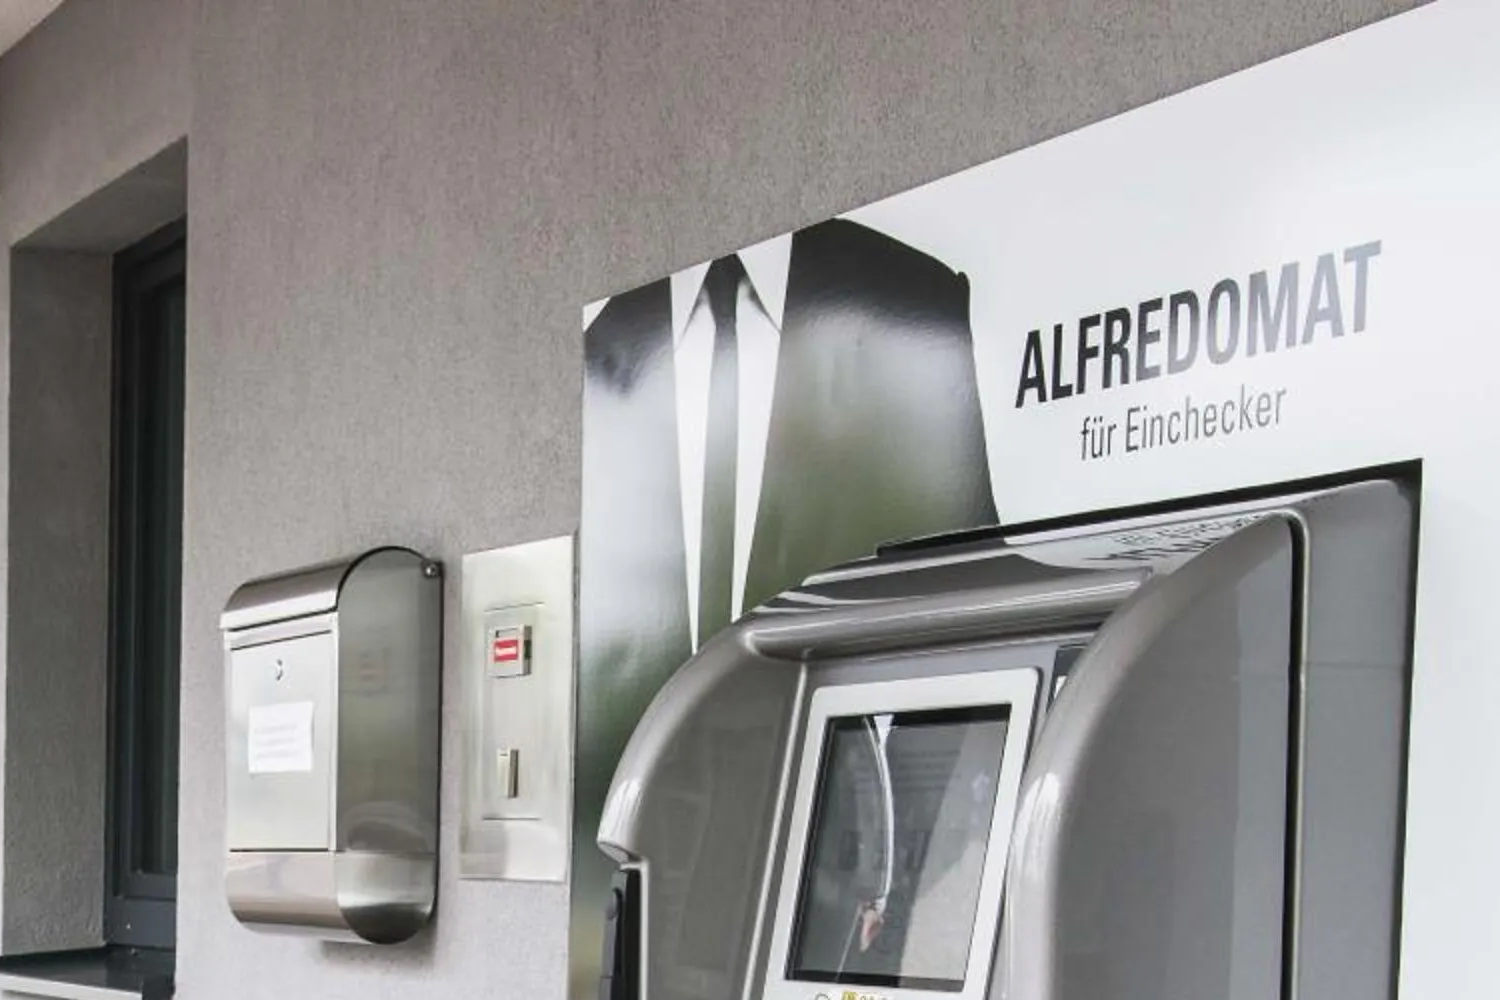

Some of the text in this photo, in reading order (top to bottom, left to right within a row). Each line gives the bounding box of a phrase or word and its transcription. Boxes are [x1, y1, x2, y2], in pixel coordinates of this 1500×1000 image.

[1014, 240, 1382, 409] ALFREDOMAT
[1080, 383, 1288, 461] für Einchecker
